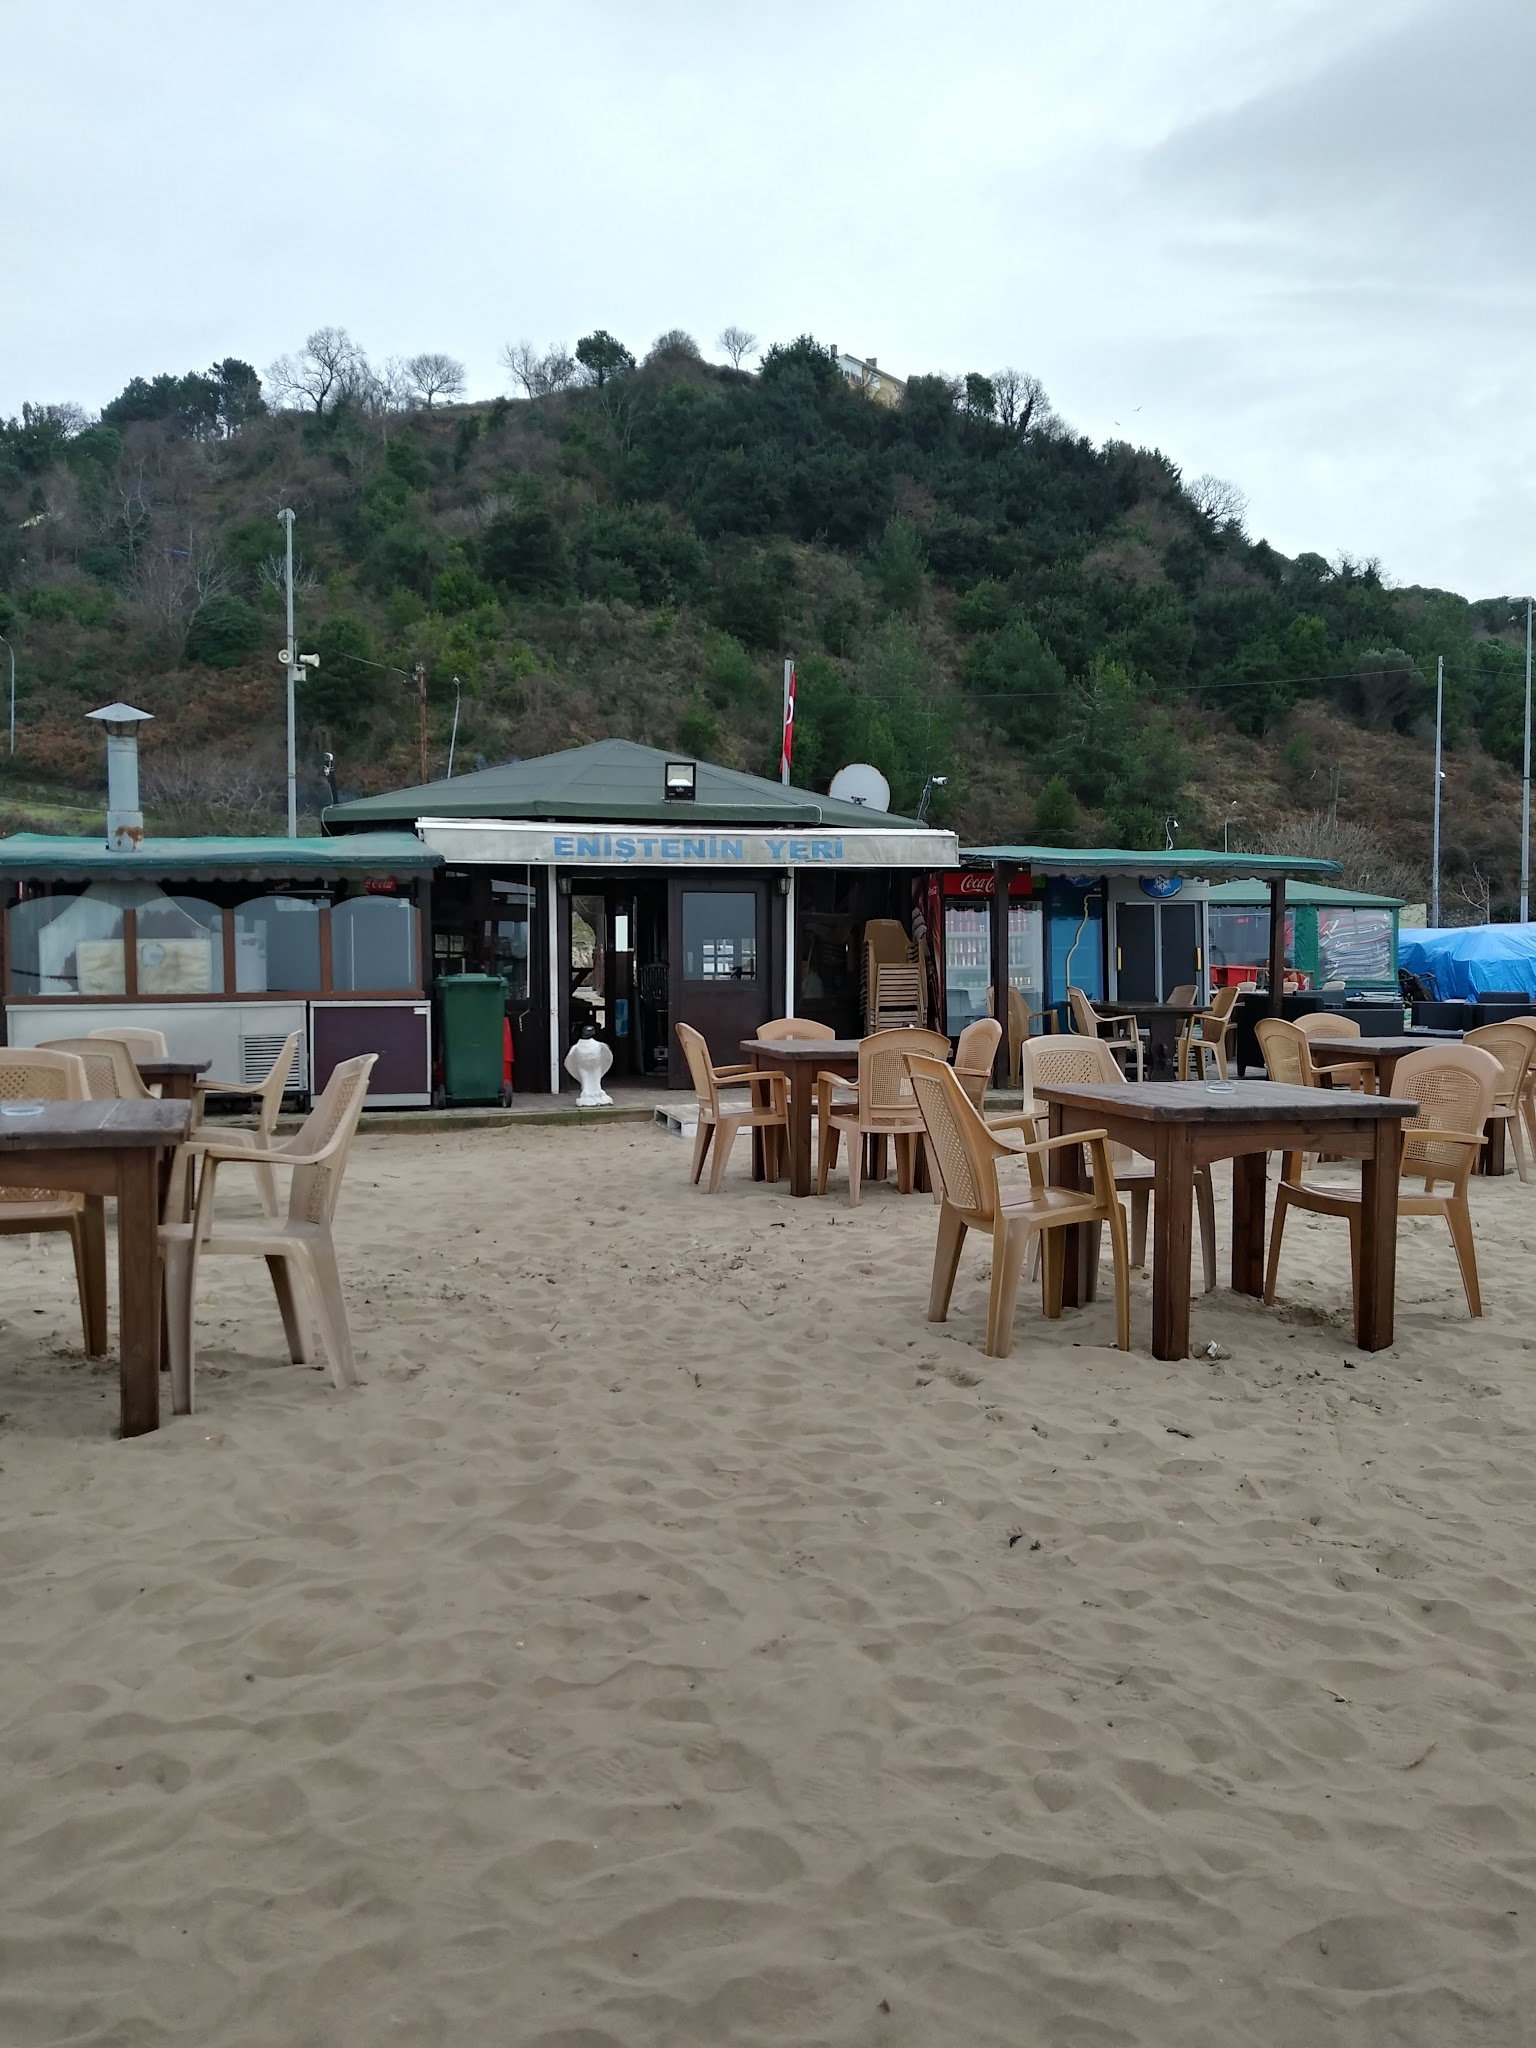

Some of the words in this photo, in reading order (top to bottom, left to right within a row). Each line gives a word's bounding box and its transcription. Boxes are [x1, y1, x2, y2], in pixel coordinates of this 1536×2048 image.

[553, 834, 743, 862] ENİŞTENİN
[764, 836, 843, 860] YERİ
[960, 873, 1011, 893] Coca-C
